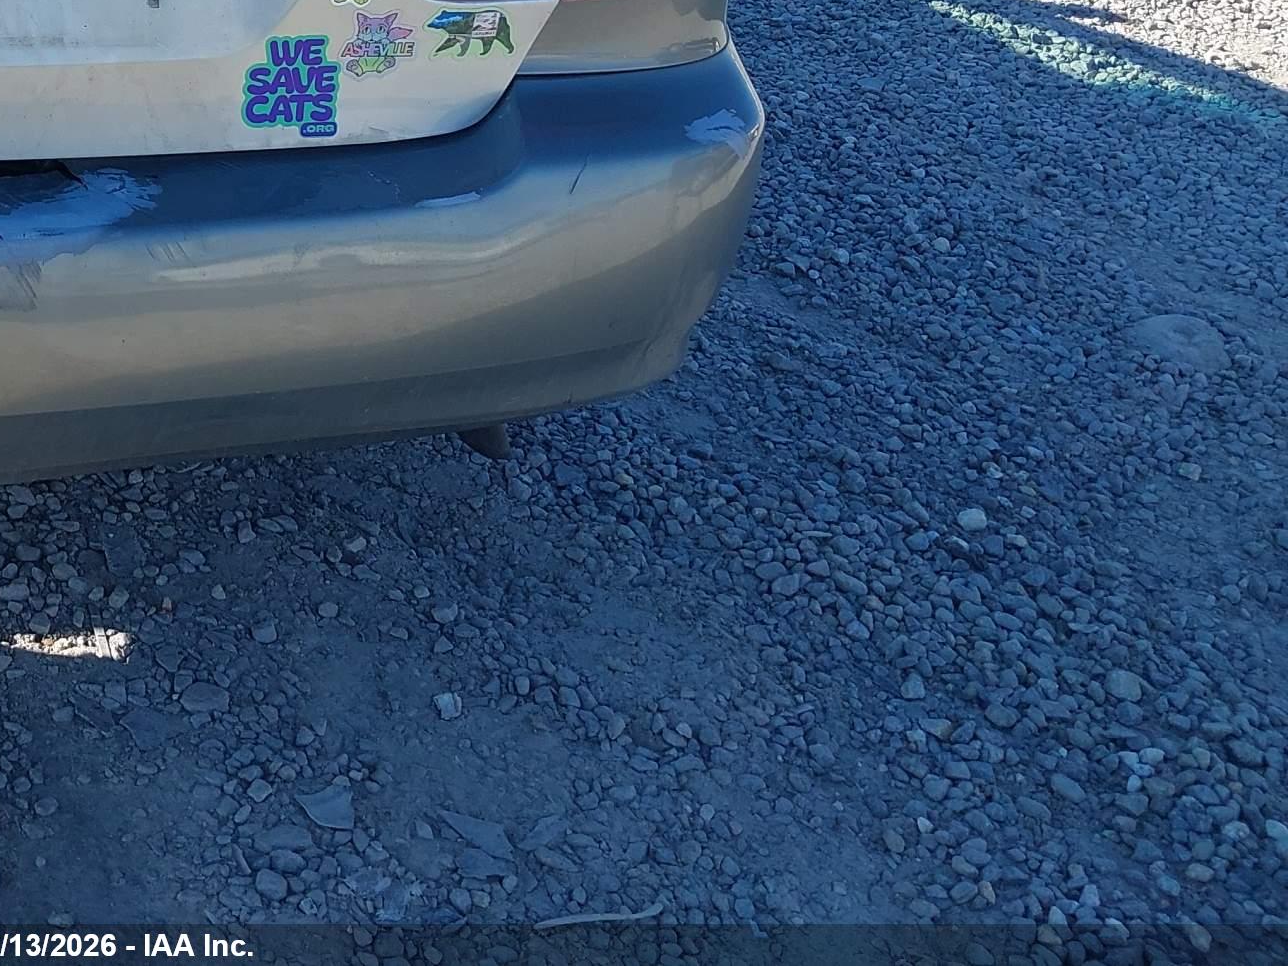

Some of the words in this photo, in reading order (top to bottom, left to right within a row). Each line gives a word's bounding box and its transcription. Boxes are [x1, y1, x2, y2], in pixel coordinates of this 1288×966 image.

[269, 38, 326, 67] WE
[341, 41, 415, 58] ASHEVILLE
[247, 66, 338, 95] SAVE
[245, 93, 334, 123] CATS
[302, 124, 335, 134] .ORG
